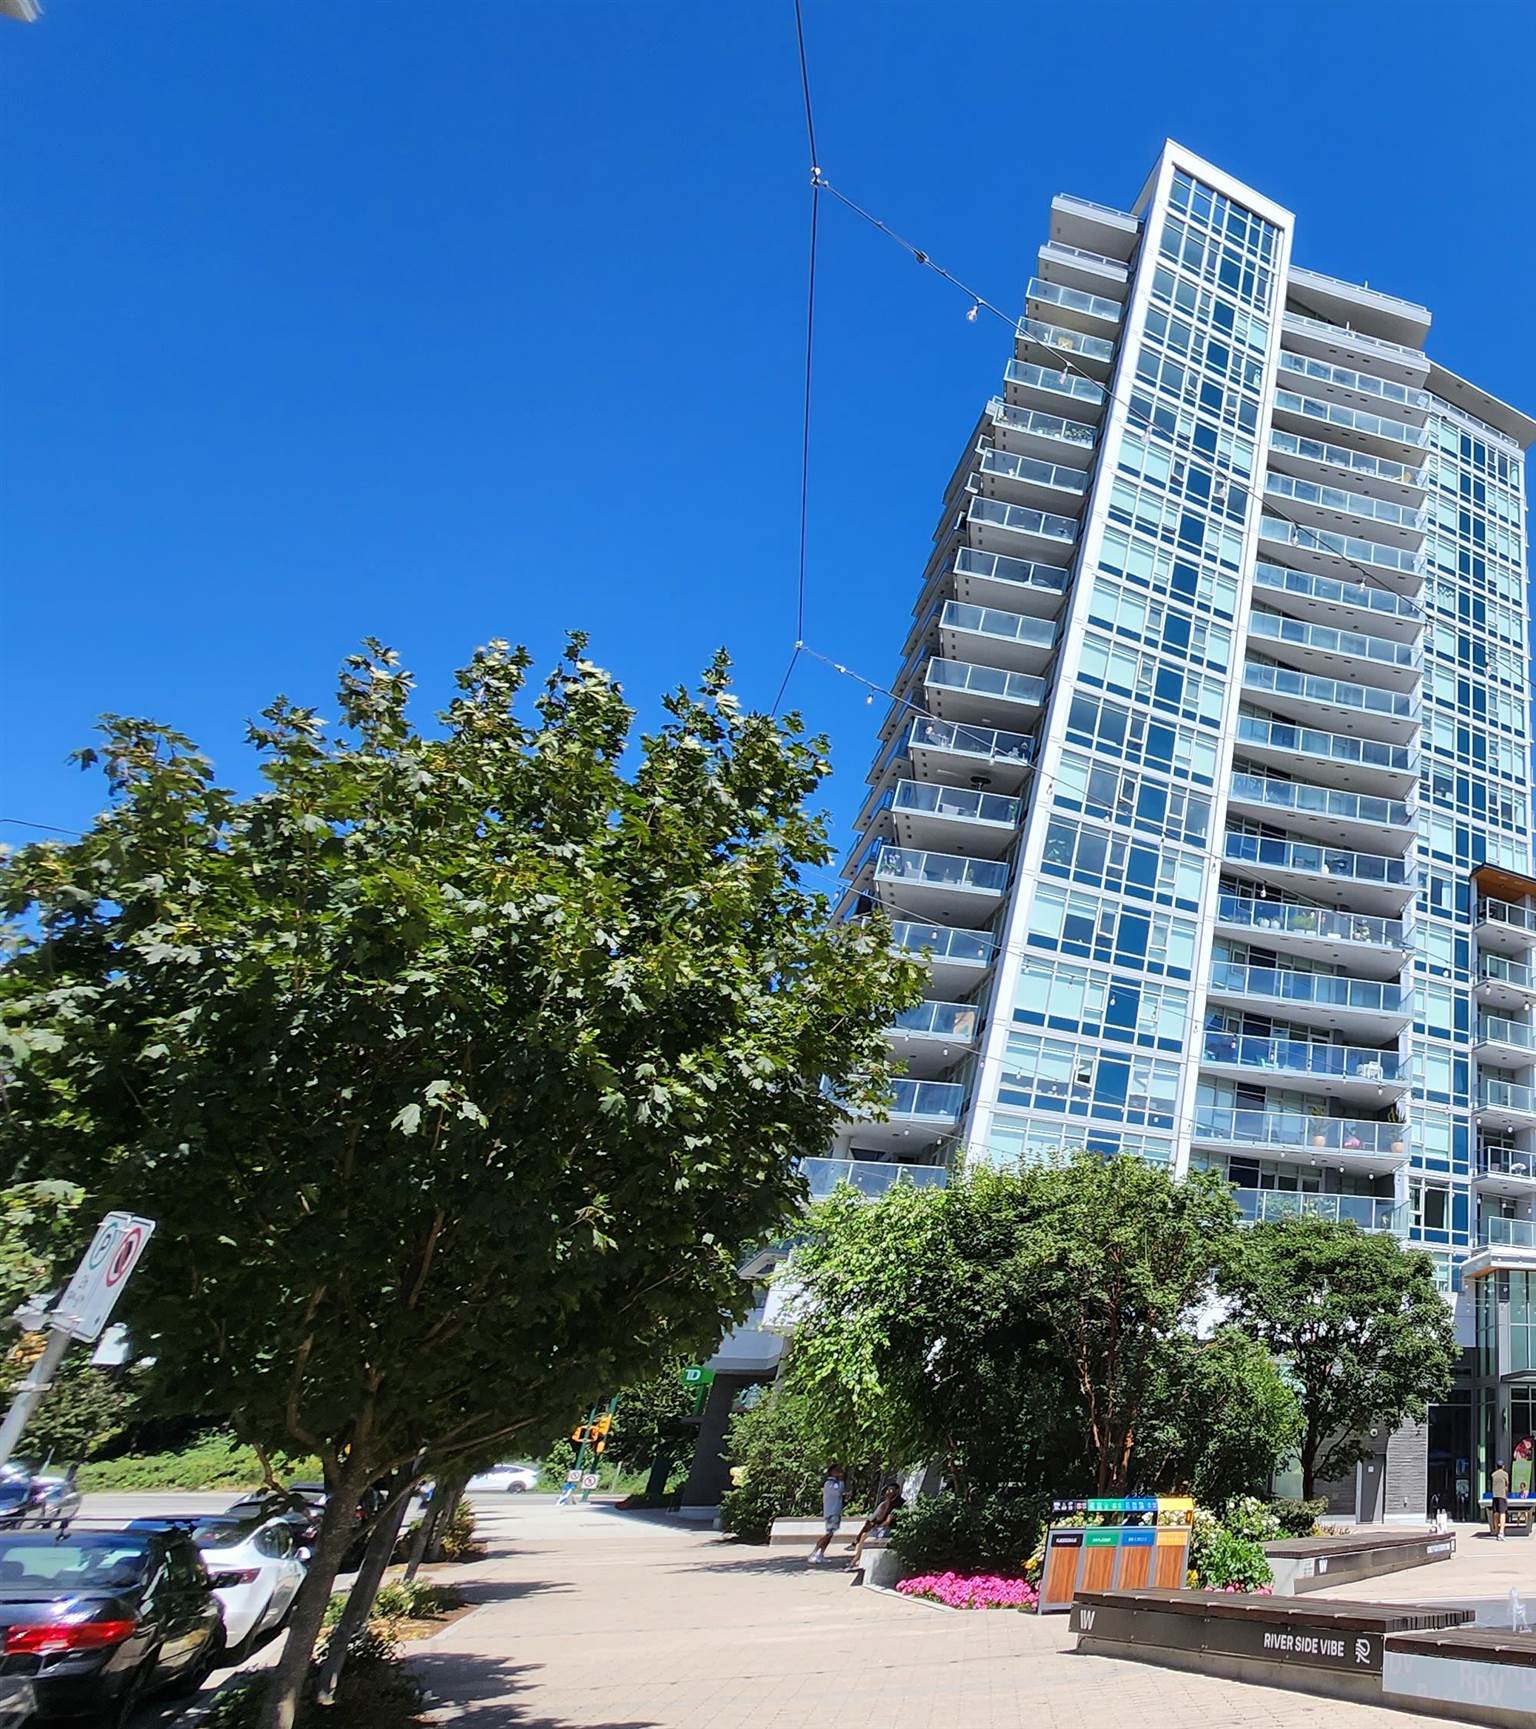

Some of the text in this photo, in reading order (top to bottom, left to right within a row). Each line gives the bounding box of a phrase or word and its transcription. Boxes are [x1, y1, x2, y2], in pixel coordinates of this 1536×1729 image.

[685, 1369, 701, 1380] TD
[1264, 1633, 1345, 1657] RIVER SIDE VIBE
